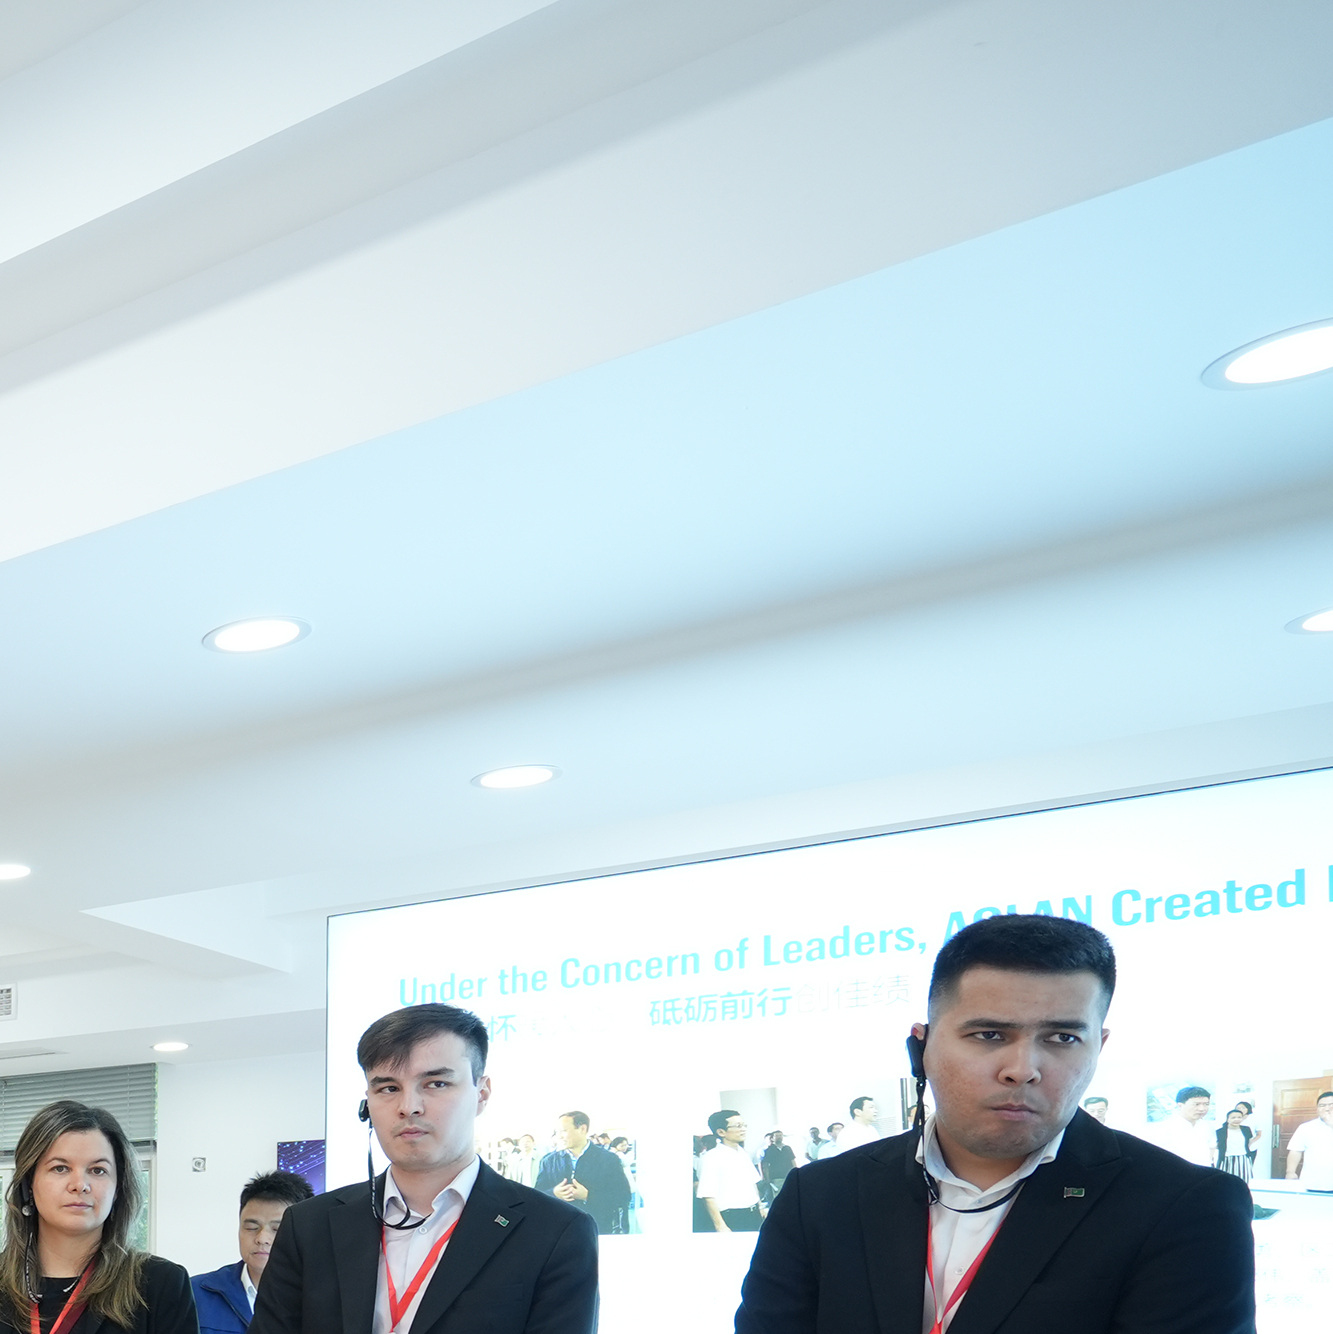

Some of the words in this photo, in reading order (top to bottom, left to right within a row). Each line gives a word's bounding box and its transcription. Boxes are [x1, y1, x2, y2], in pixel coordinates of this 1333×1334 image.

[398, 972, 487, 1007] Under
[498, 965, 548, 996] the
[560, 948, 700, 989] Concern
[714, 937, 750, 971] of
[763, 924, 928, 967] Leaders,
[1112, 868, 1306, 927] Created
